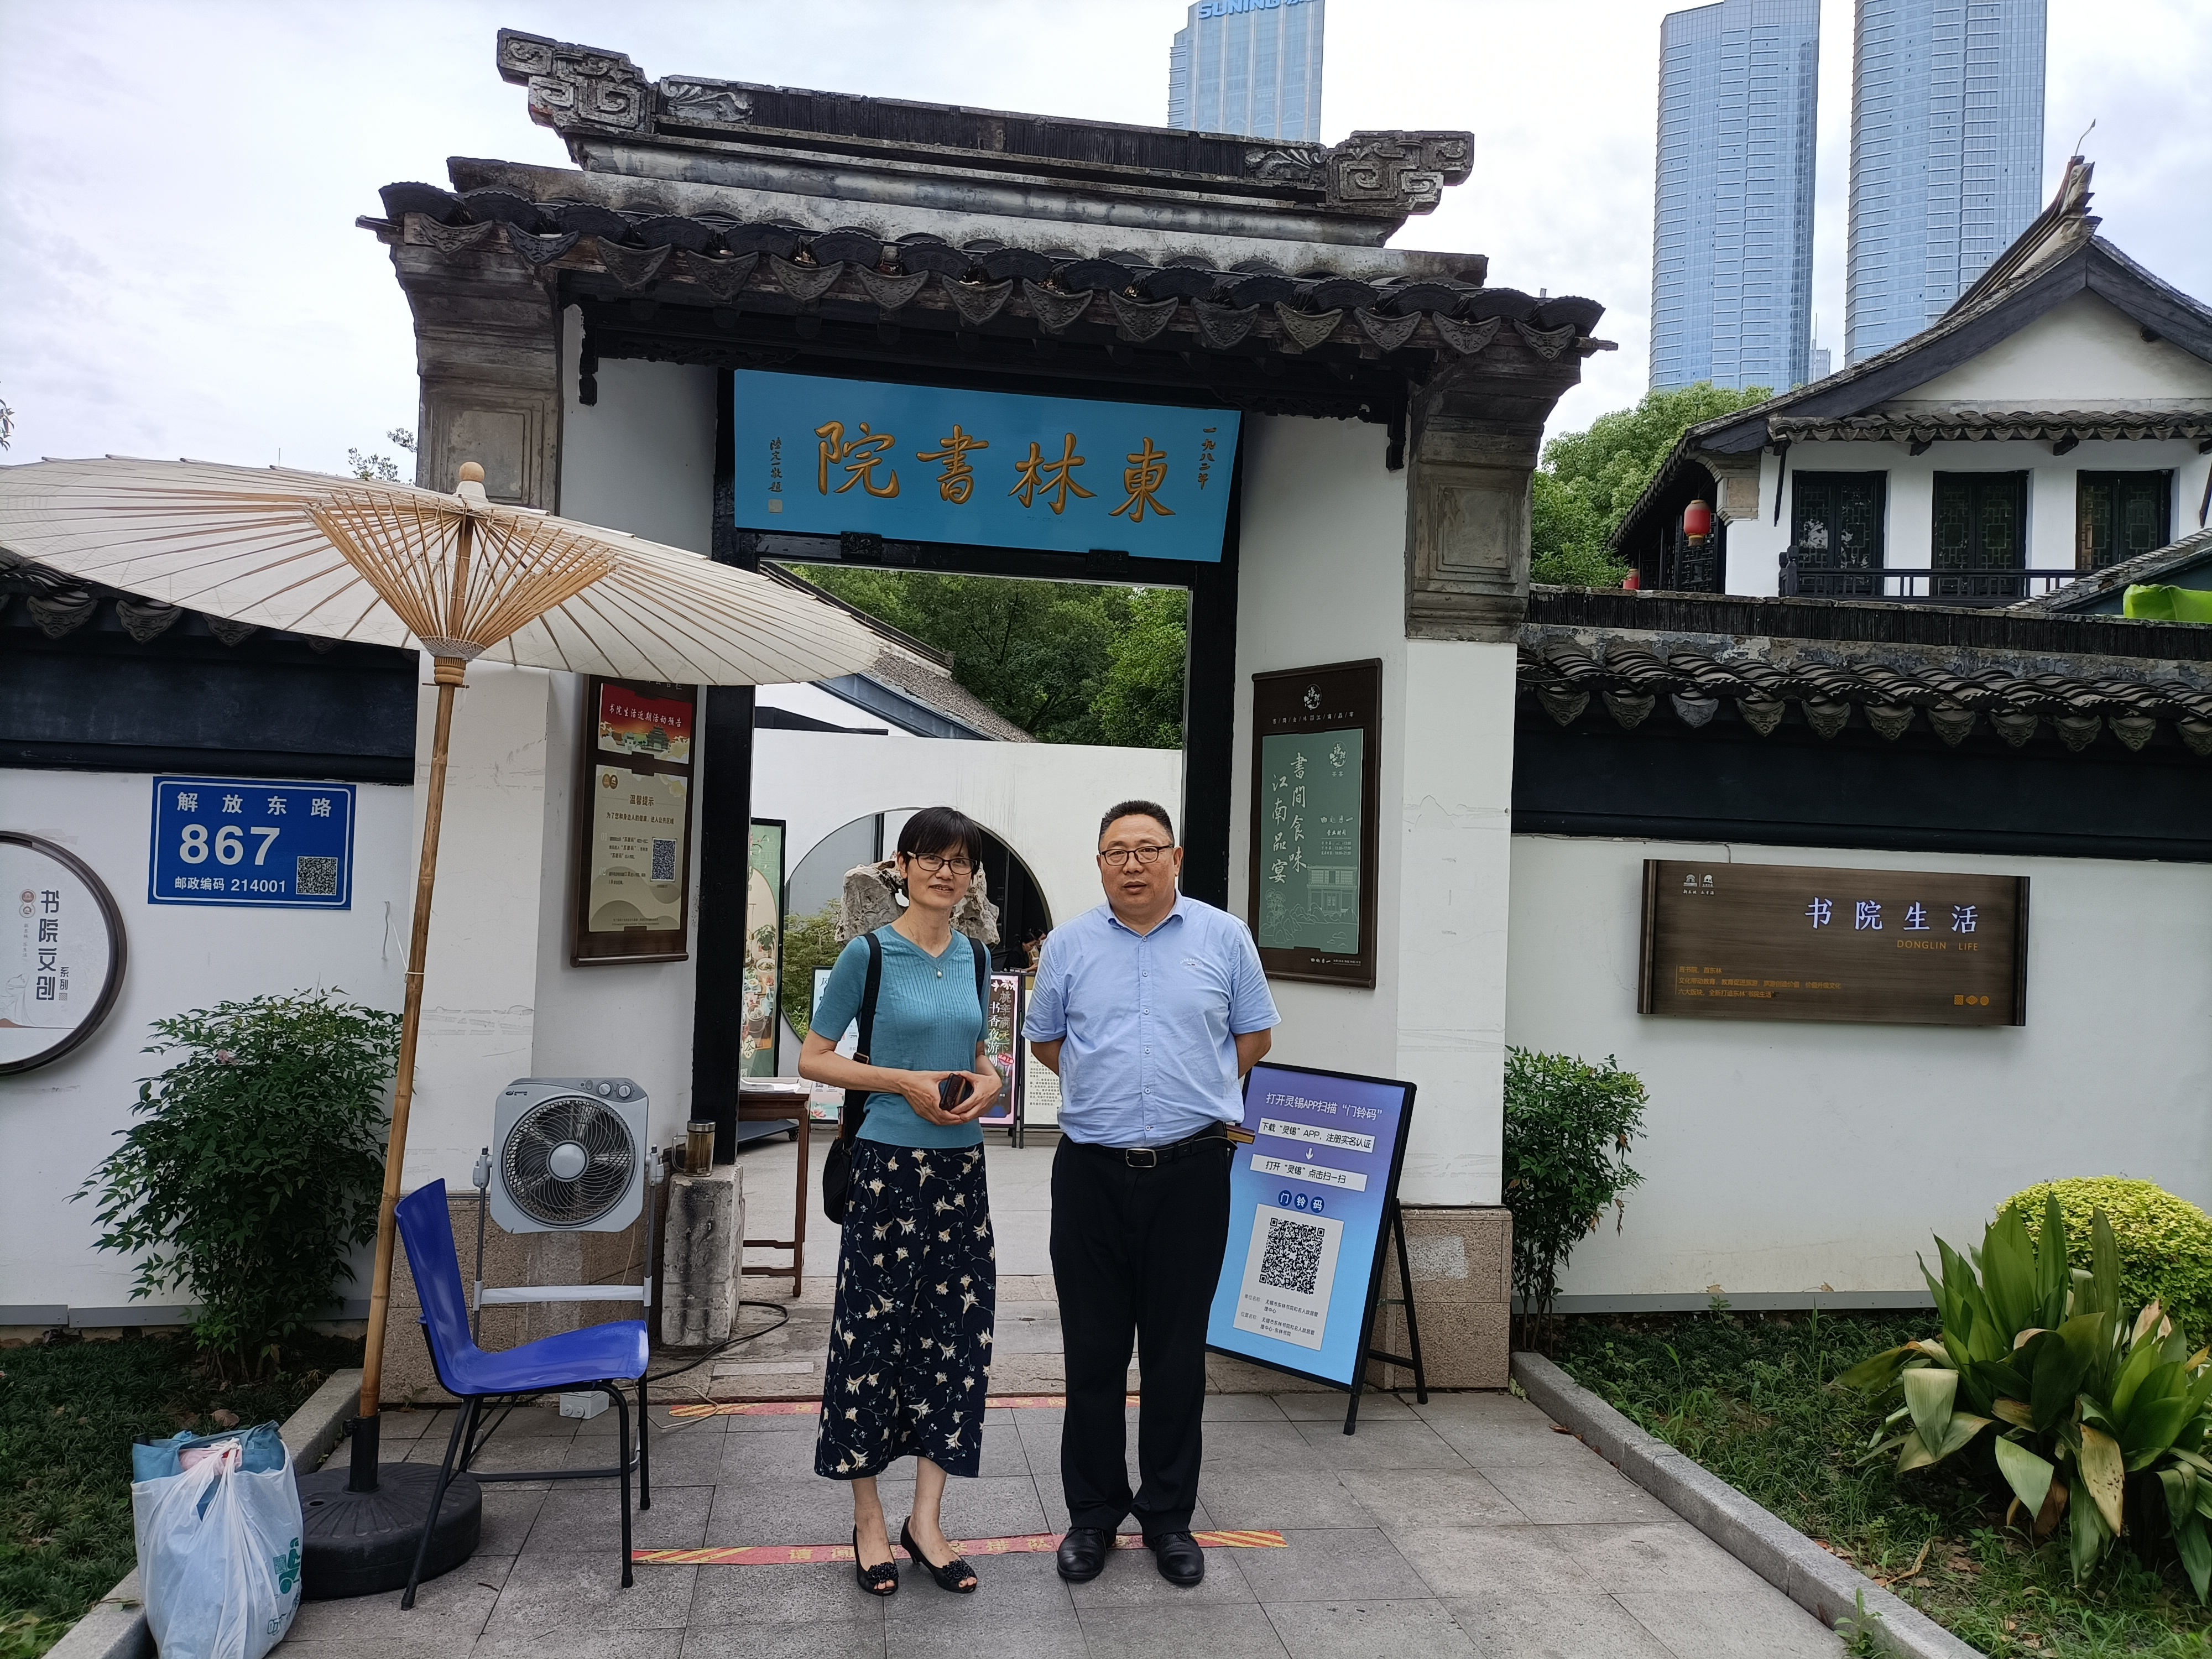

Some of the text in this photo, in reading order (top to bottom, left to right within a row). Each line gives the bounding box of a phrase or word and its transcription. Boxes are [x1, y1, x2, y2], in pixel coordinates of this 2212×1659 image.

[177, 792, 331, 817] 解放东路
[629, 794, 654, 806] 温馨提示
[179, 824, 280, 865] 867
[175, 877, 285, 893] 邮政编码 214001
[1804, 896, 1978, 933] 书院生活
[1897, 940, 1978, 951] DONGLIN LIFE
[59, 967, 69, 990] 系列
[999, 991, 1011, 1053] 桃李满天下
[745, 1039, 755, 1056] 茶
[1280, 1193, 1323, 1211] 门铃码
